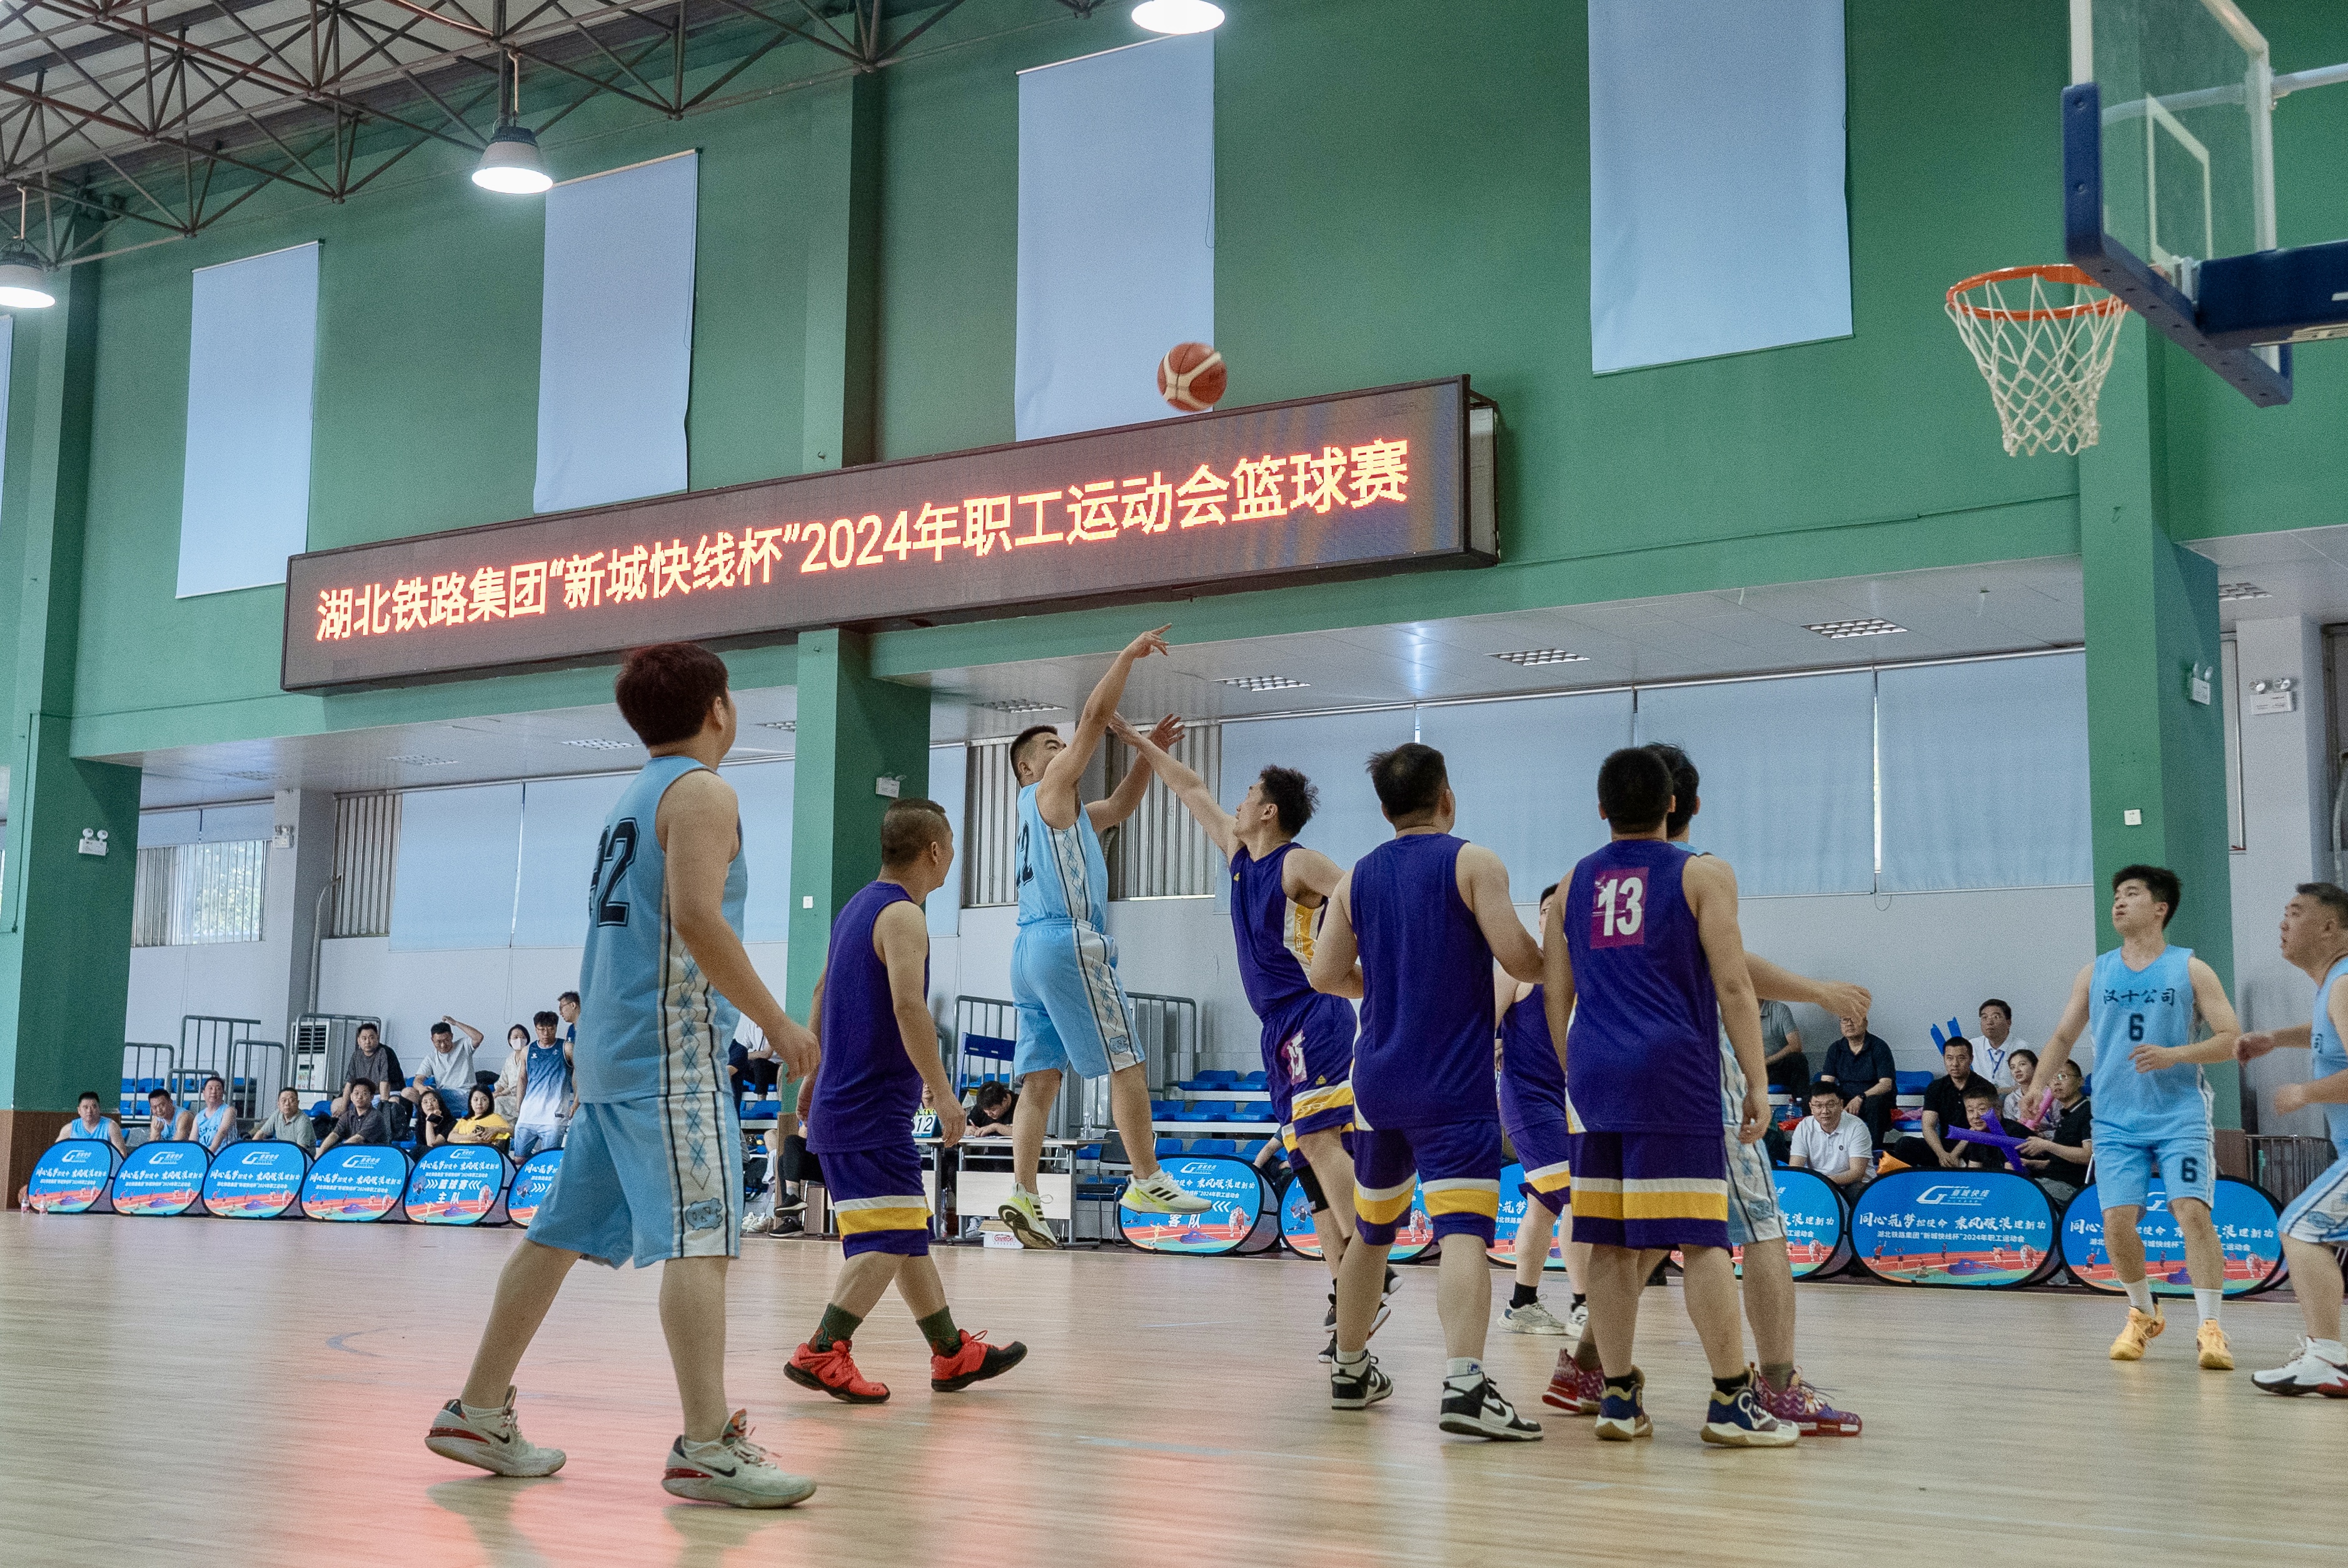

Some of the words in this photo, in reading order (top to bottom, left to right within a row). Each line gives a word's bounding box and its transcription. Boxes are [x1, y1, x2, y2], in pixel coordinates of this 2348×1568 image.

[316, 438, 1409, 641] 湖北铁路集团“新城快线杯”2024年职工运动会篮球赛
[1598, 877, 1643, 936] 13
[2104, 988, 2175, 1006] 汉十公司
[2129, 1012, 2145, 1042] 6
[2180, 1157, 2198, 1183] 6
[436, 1191, 460, 1205] 主队
[1168, 1214, 1202, 1229] 客队
[1860, 1212, 1948, 1229] 同心筑梦担使命
[1955, 1216, 2047, 1231] 乘风破浪建新功
